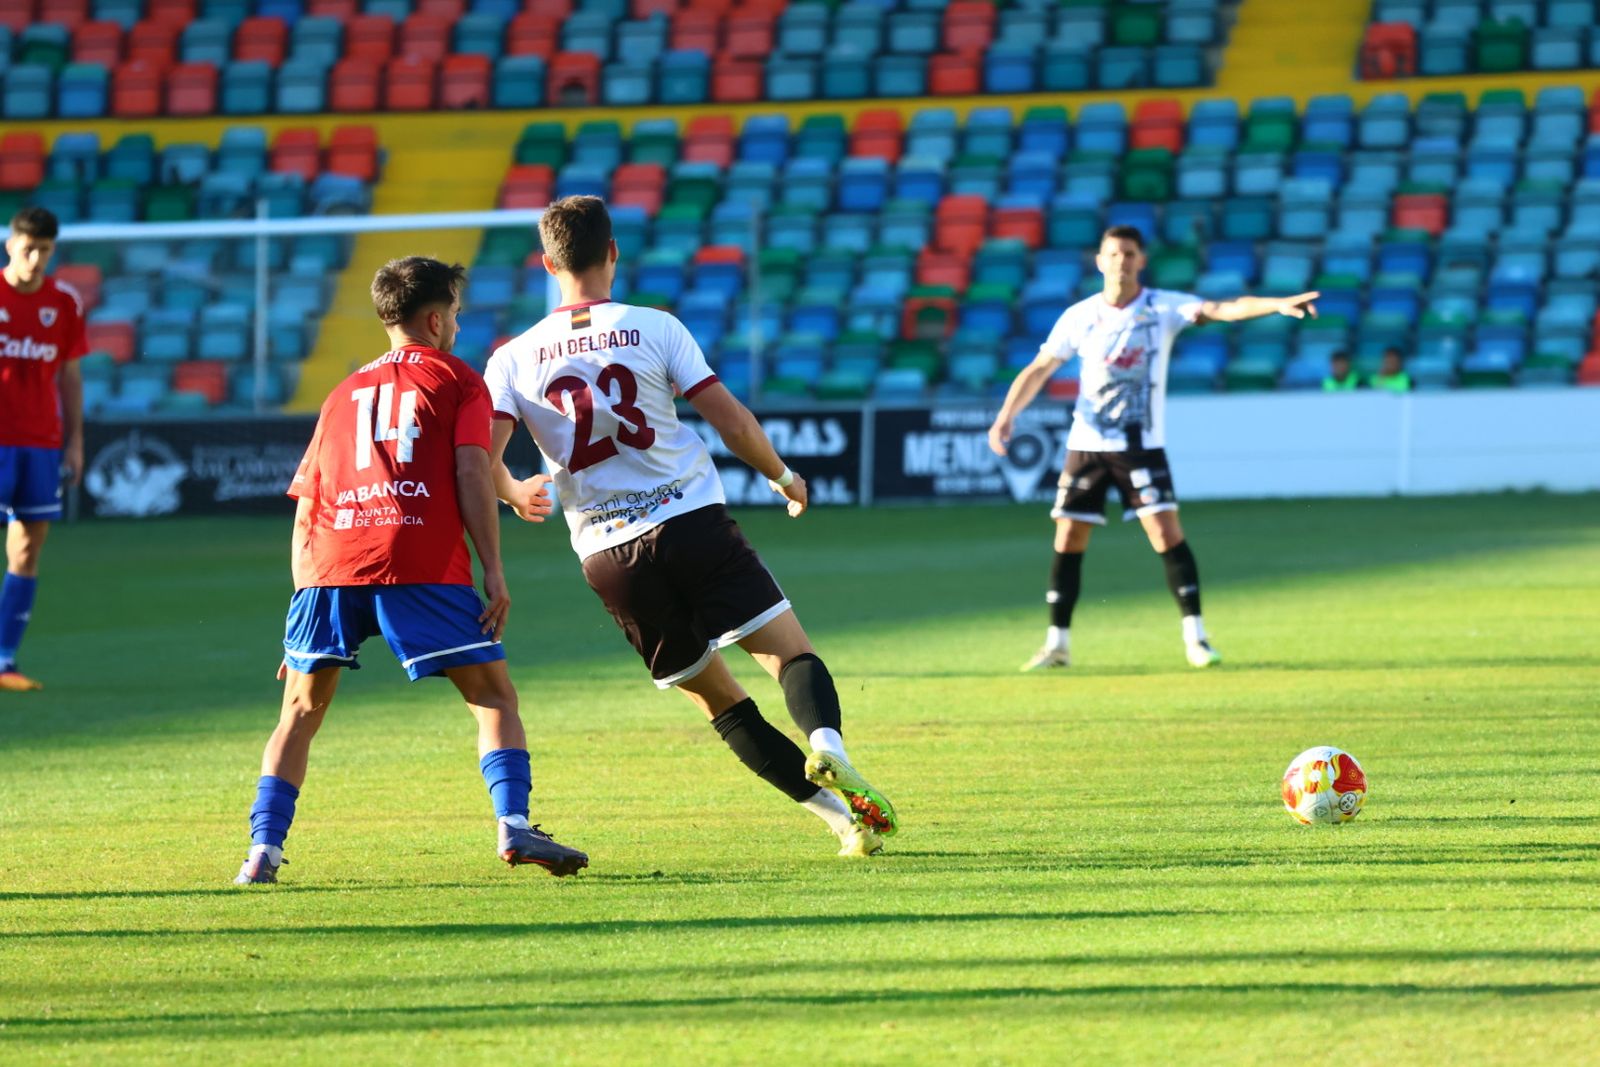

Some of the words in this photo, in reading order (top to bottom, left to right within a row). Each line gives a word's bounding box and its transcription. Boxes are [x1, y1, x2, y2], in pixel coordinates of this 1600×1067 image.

[407, 351, 424, 364] G.
[532, 340, 563, 366] JAVI
[567, 329, 640, 356] DELGADO
[351, 382, 421, 472] 14
[544, 363, 656, 475] 23
[340, 480, 430, 505] ABANCA
[355, 518, 371, 527] DE
[375, 515, 424, 527] GALICIA
[357, 506, 398, 518] XUNTA
